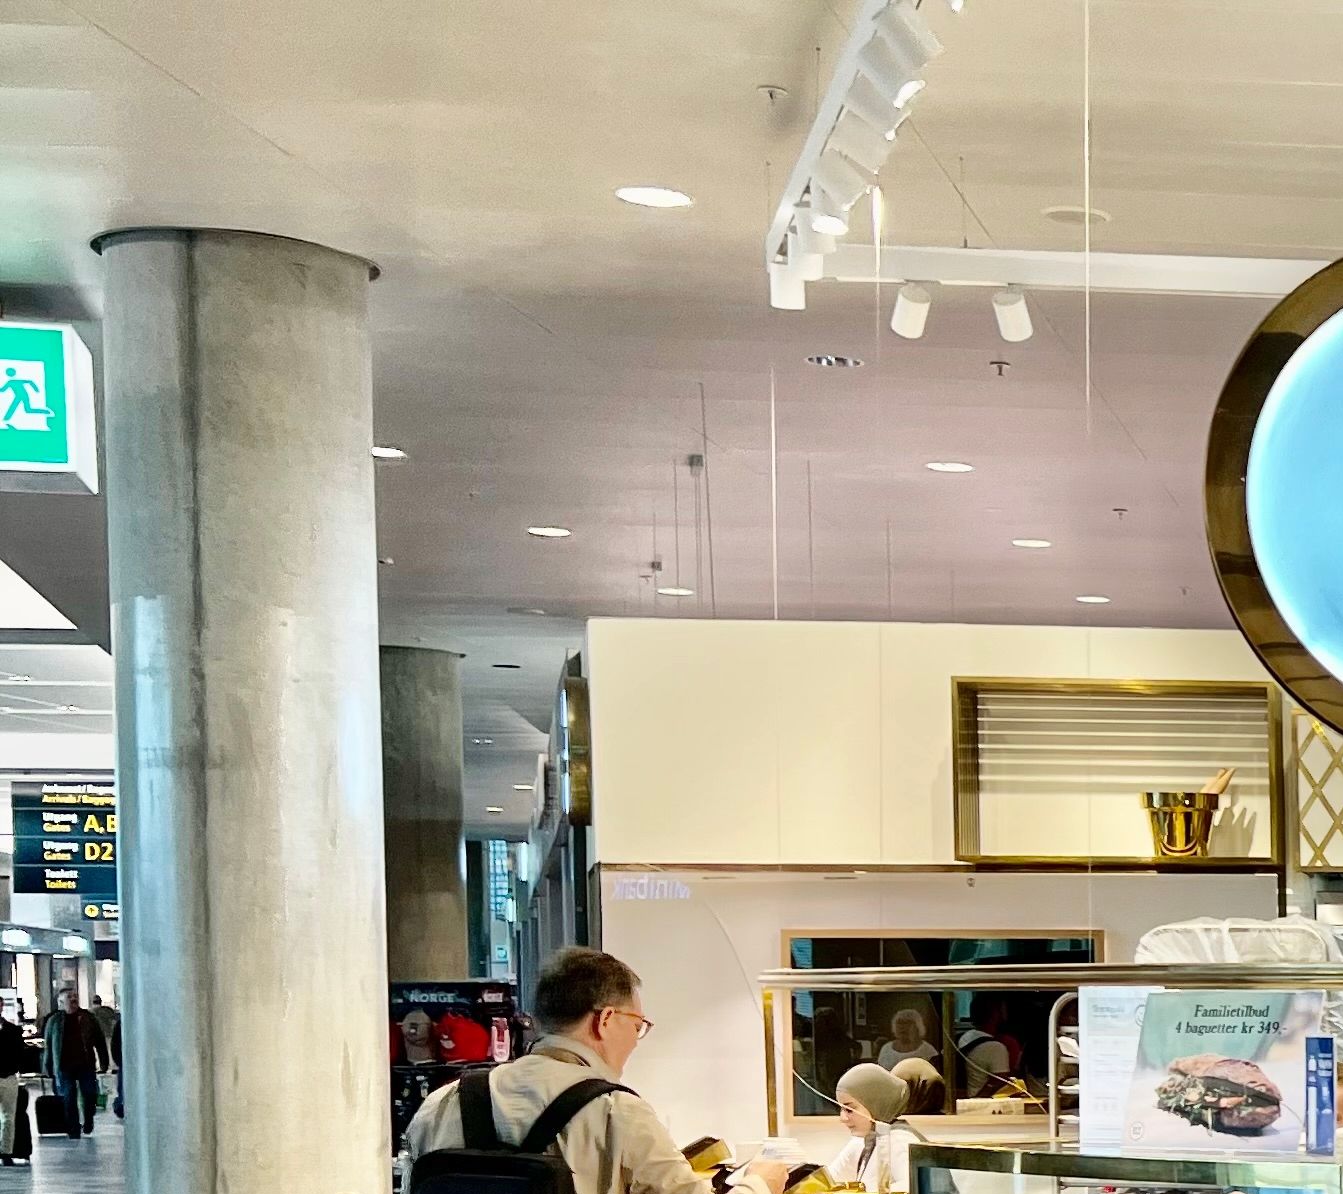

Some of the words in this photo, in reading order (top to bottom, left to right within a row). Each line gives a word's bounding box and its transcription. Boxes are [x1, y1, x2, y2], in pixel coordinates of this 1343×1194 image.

[84, 842, 114, 860] D2
[1194, 1004, 1270, 1018] Familietilbud
[1175, 1022, 1182, 1034] 4
[1185, 1022, 1238, 1036] baguetter
[1241, 1022, 1254, 1034] kr
